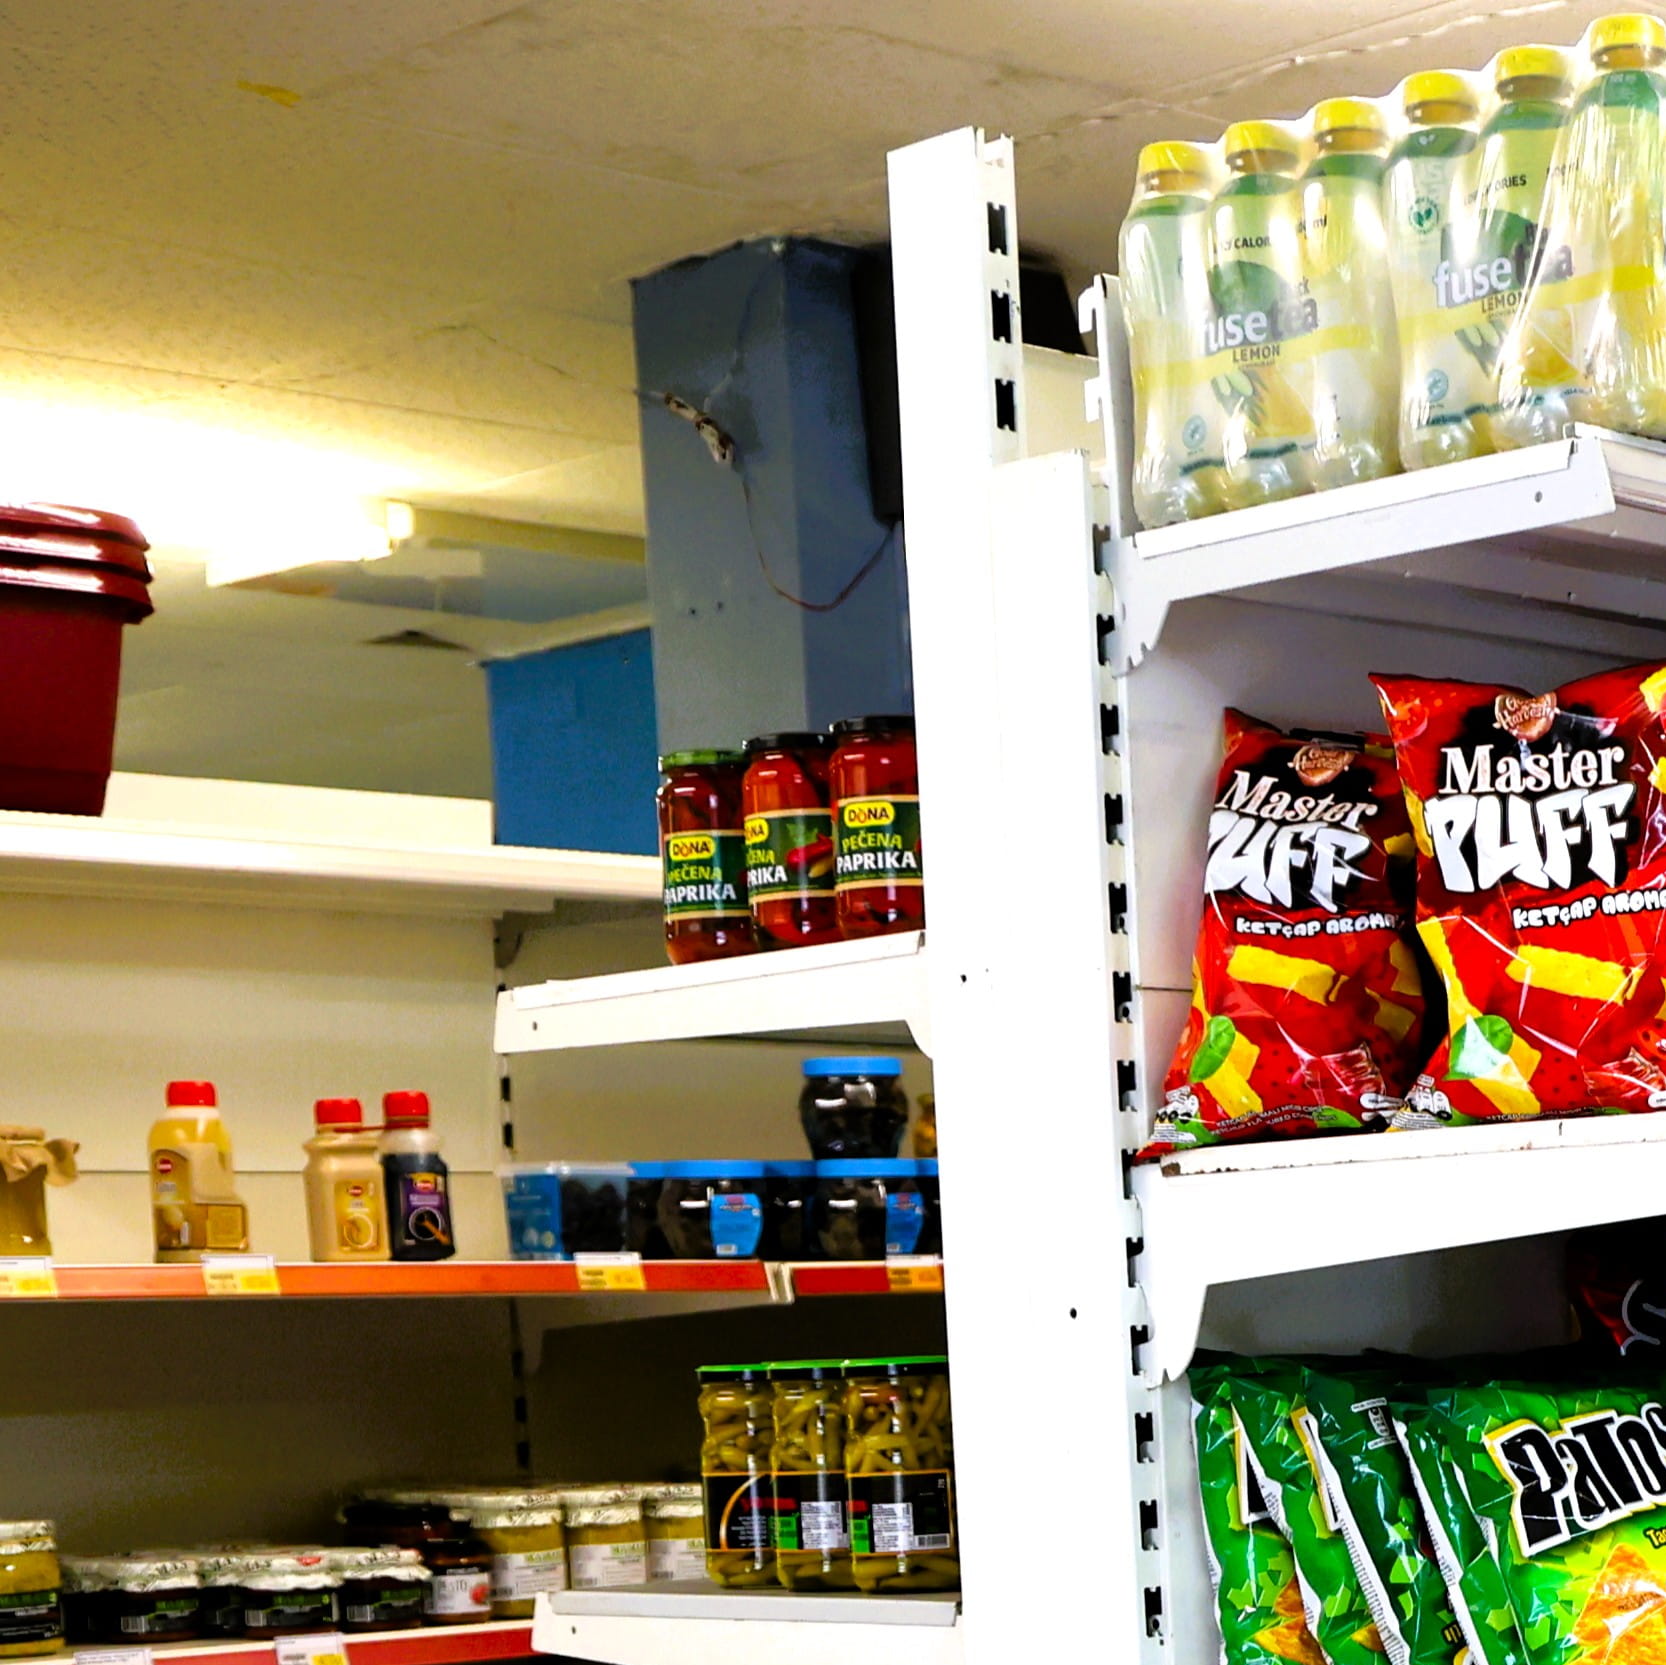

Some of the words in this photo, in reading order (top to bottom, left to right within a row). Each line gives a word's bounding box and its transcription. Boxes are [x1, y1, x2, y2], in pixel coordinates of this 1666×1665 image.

[1438, 741, 1626, 795] Master
[1215, 769, 1379, 832] Master
[841, 833, 903, 851] PEČENA
[1424, 782, 1637, 894] PUFF
[836, 850, 938, 874] PAPRIKA
[665, 884, 738, 904] PAPRIKA
[1236, 916, 1322, 939] KETÇAP
[1512, 897, 1598, 930] KETÇAP
